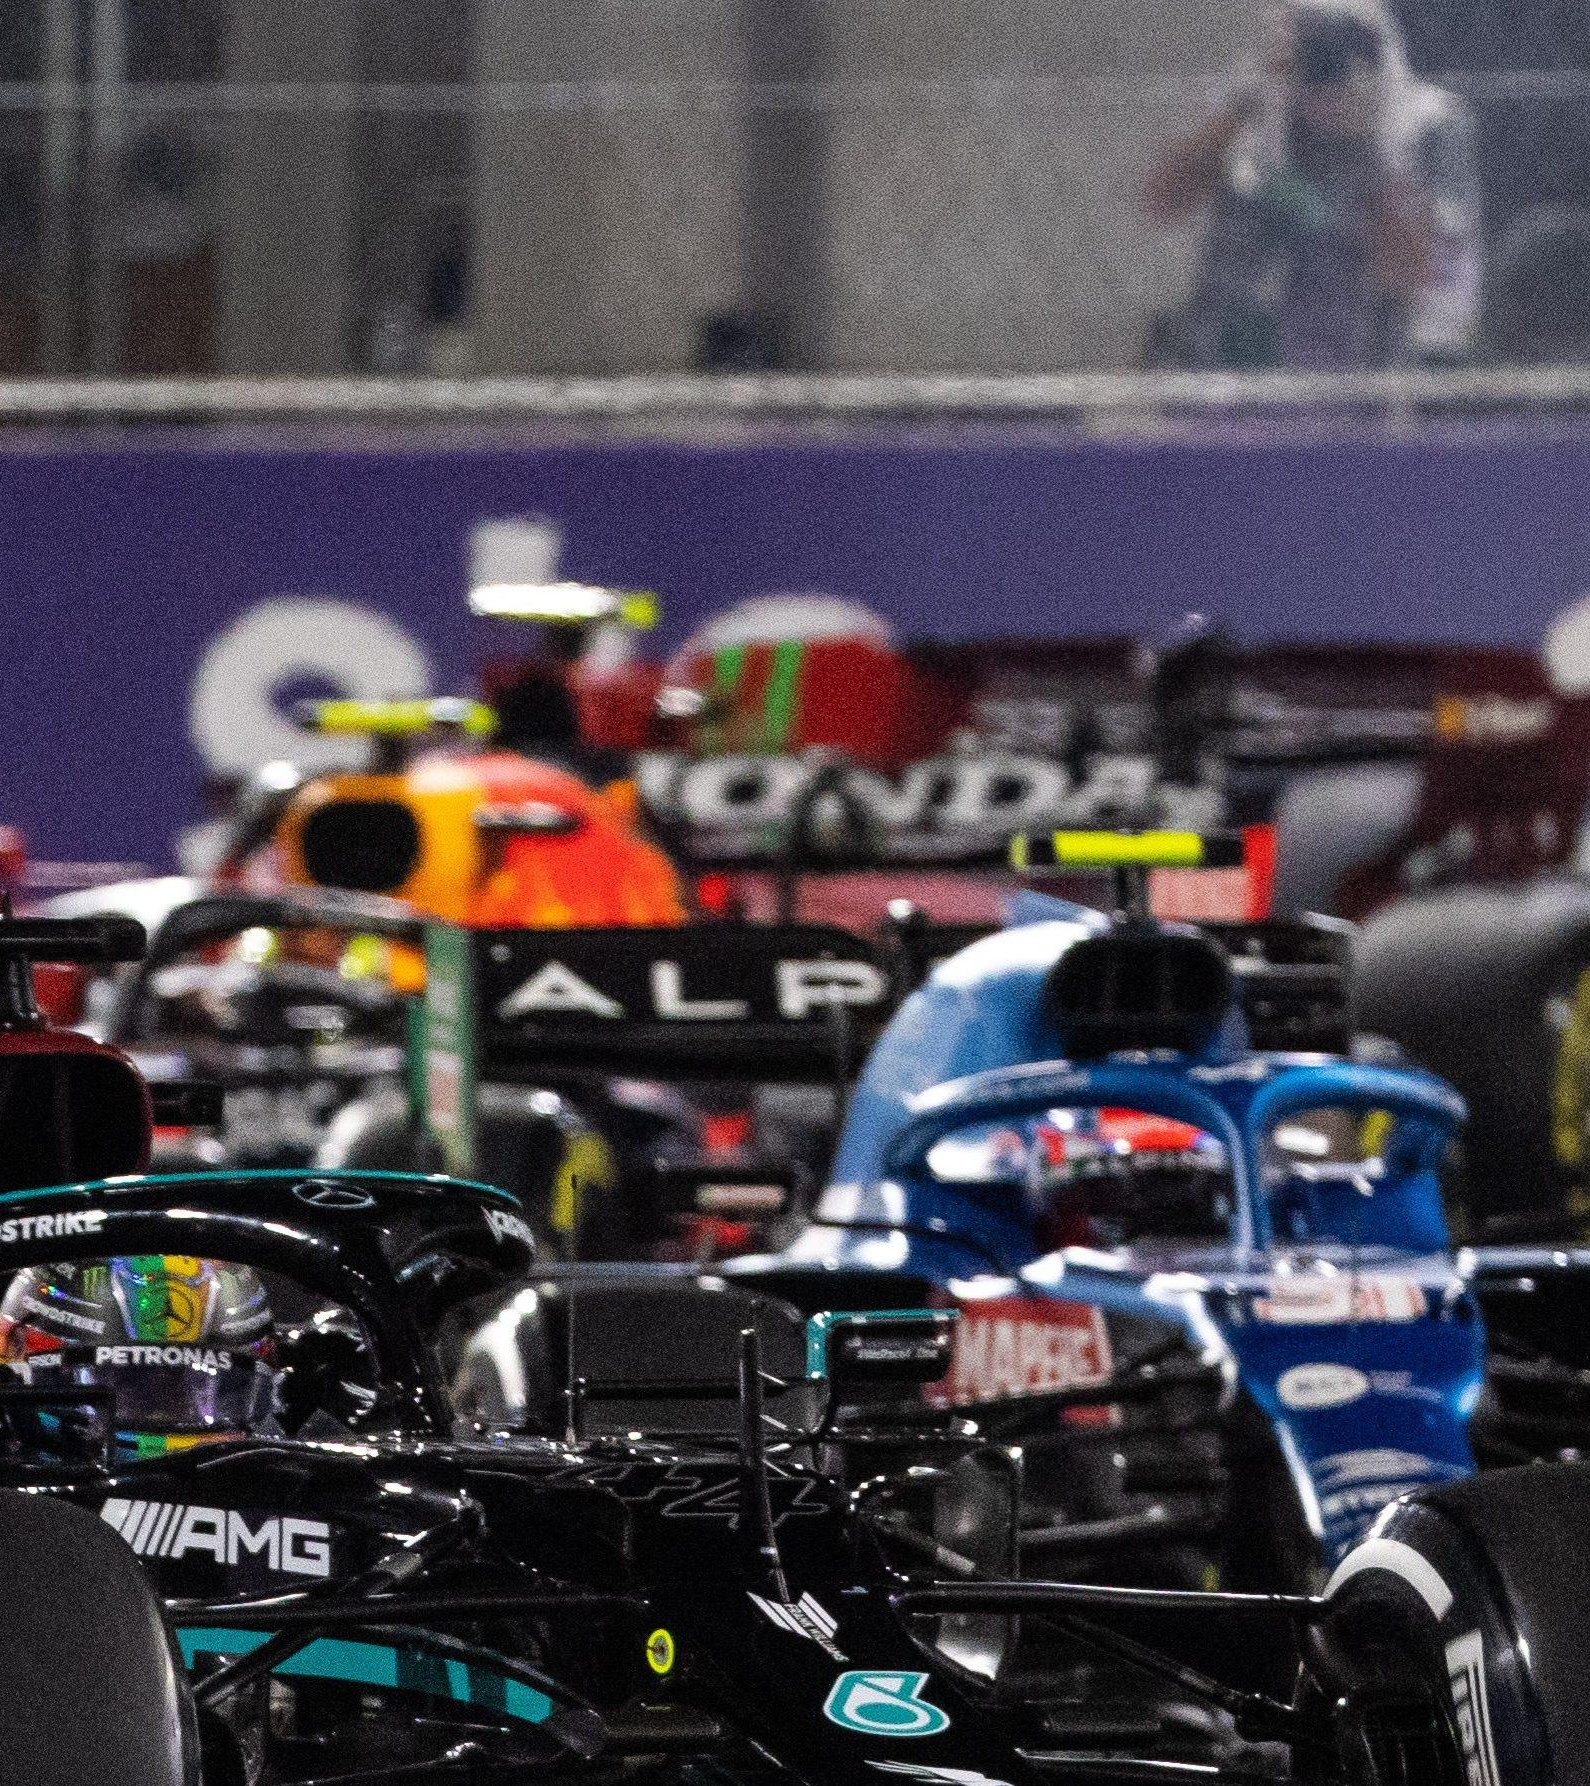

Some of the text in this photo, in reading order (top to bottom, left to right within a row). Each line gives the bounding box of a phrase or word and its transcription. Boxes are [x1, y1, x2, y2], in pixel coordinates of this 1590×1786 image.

[499, 958, 889, 1018] ALP
[96, 1345, 233, 1369] PETRONAS
[176, 1502, 333, 1578] AMG
